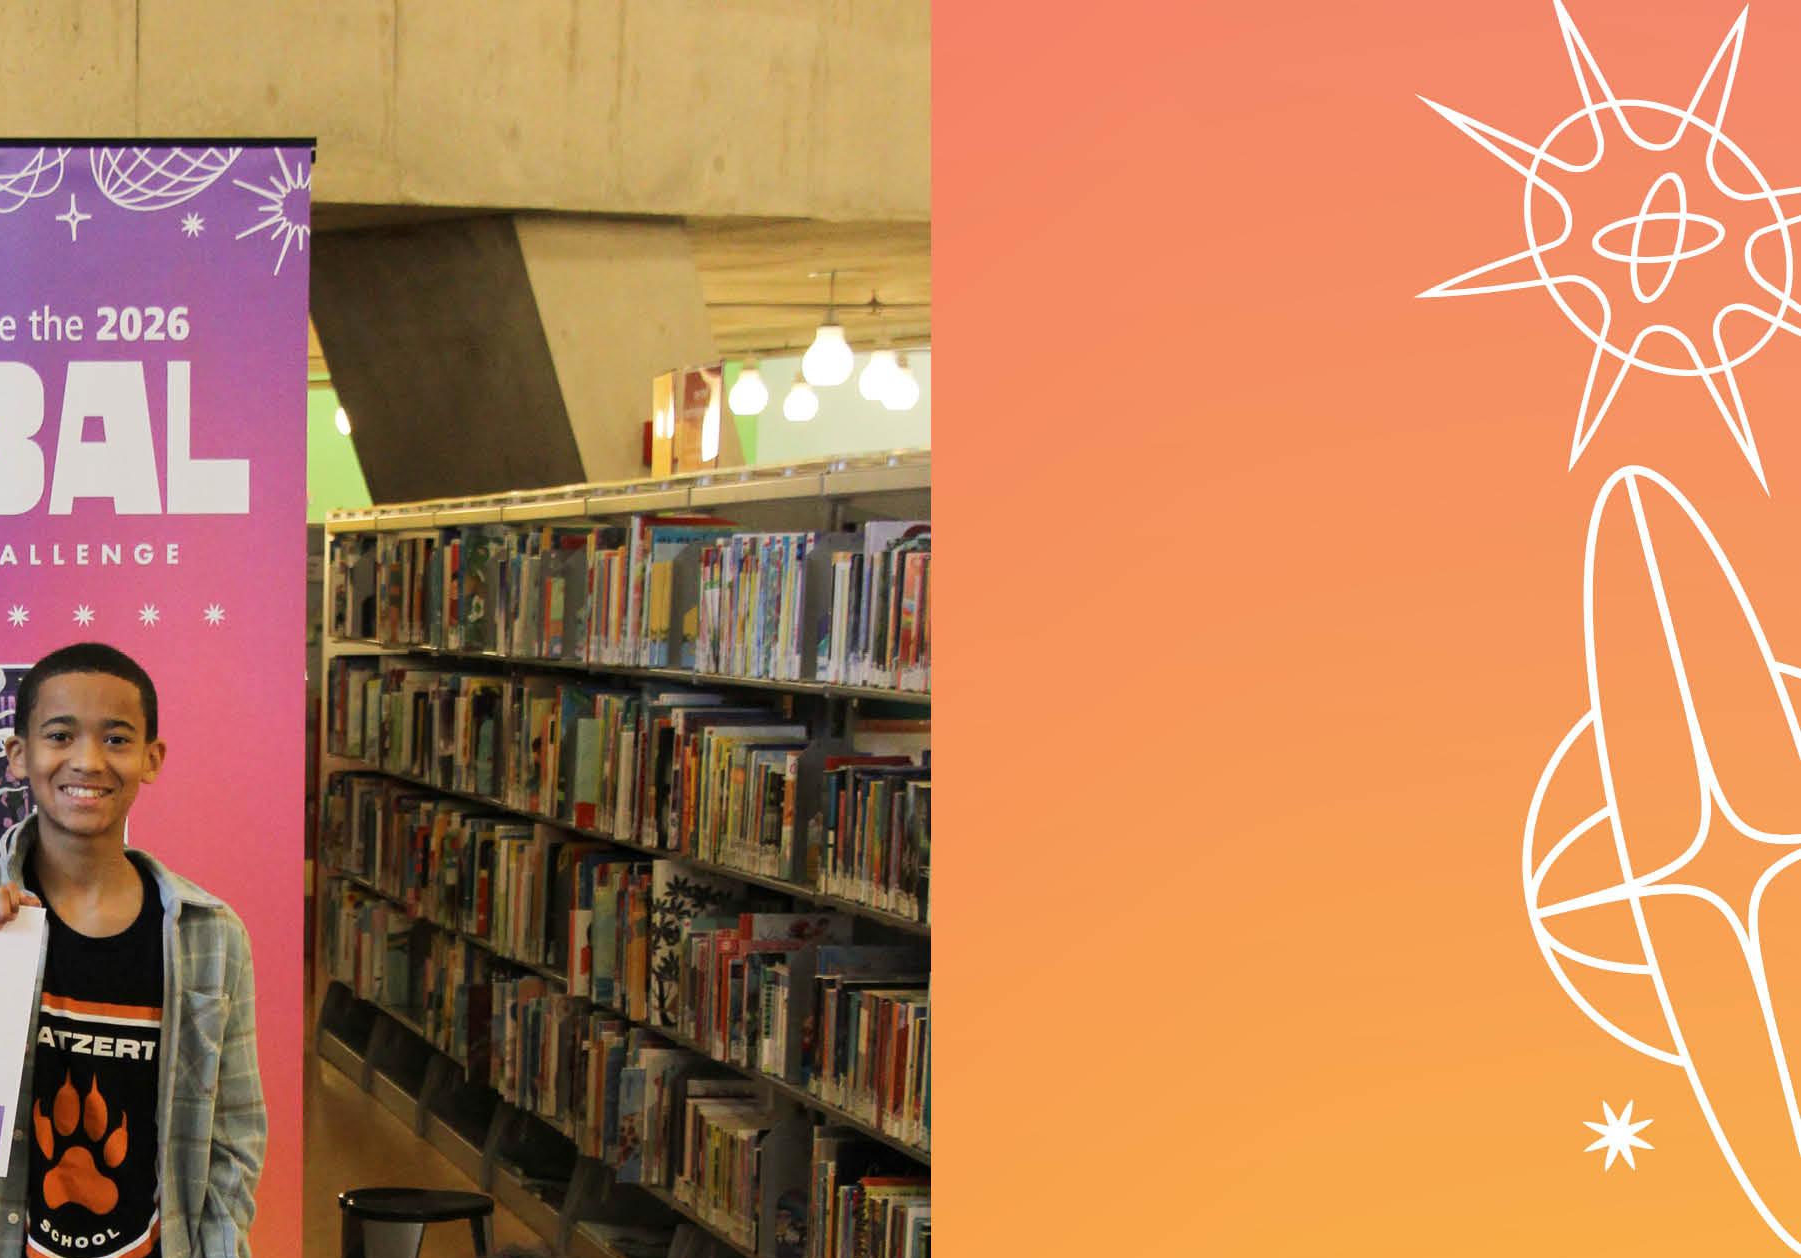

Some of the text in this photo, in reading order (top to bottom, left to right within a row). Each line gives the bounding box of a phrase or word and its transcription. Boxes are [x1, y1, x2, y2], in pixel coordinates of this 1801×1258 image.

[29, 306, 83, 341] the
[96, 306, 190, 341] 2026
[36, 1025, 156, 1061] ATZERT
[39, 1218, 121, 1249] SCHOOL
